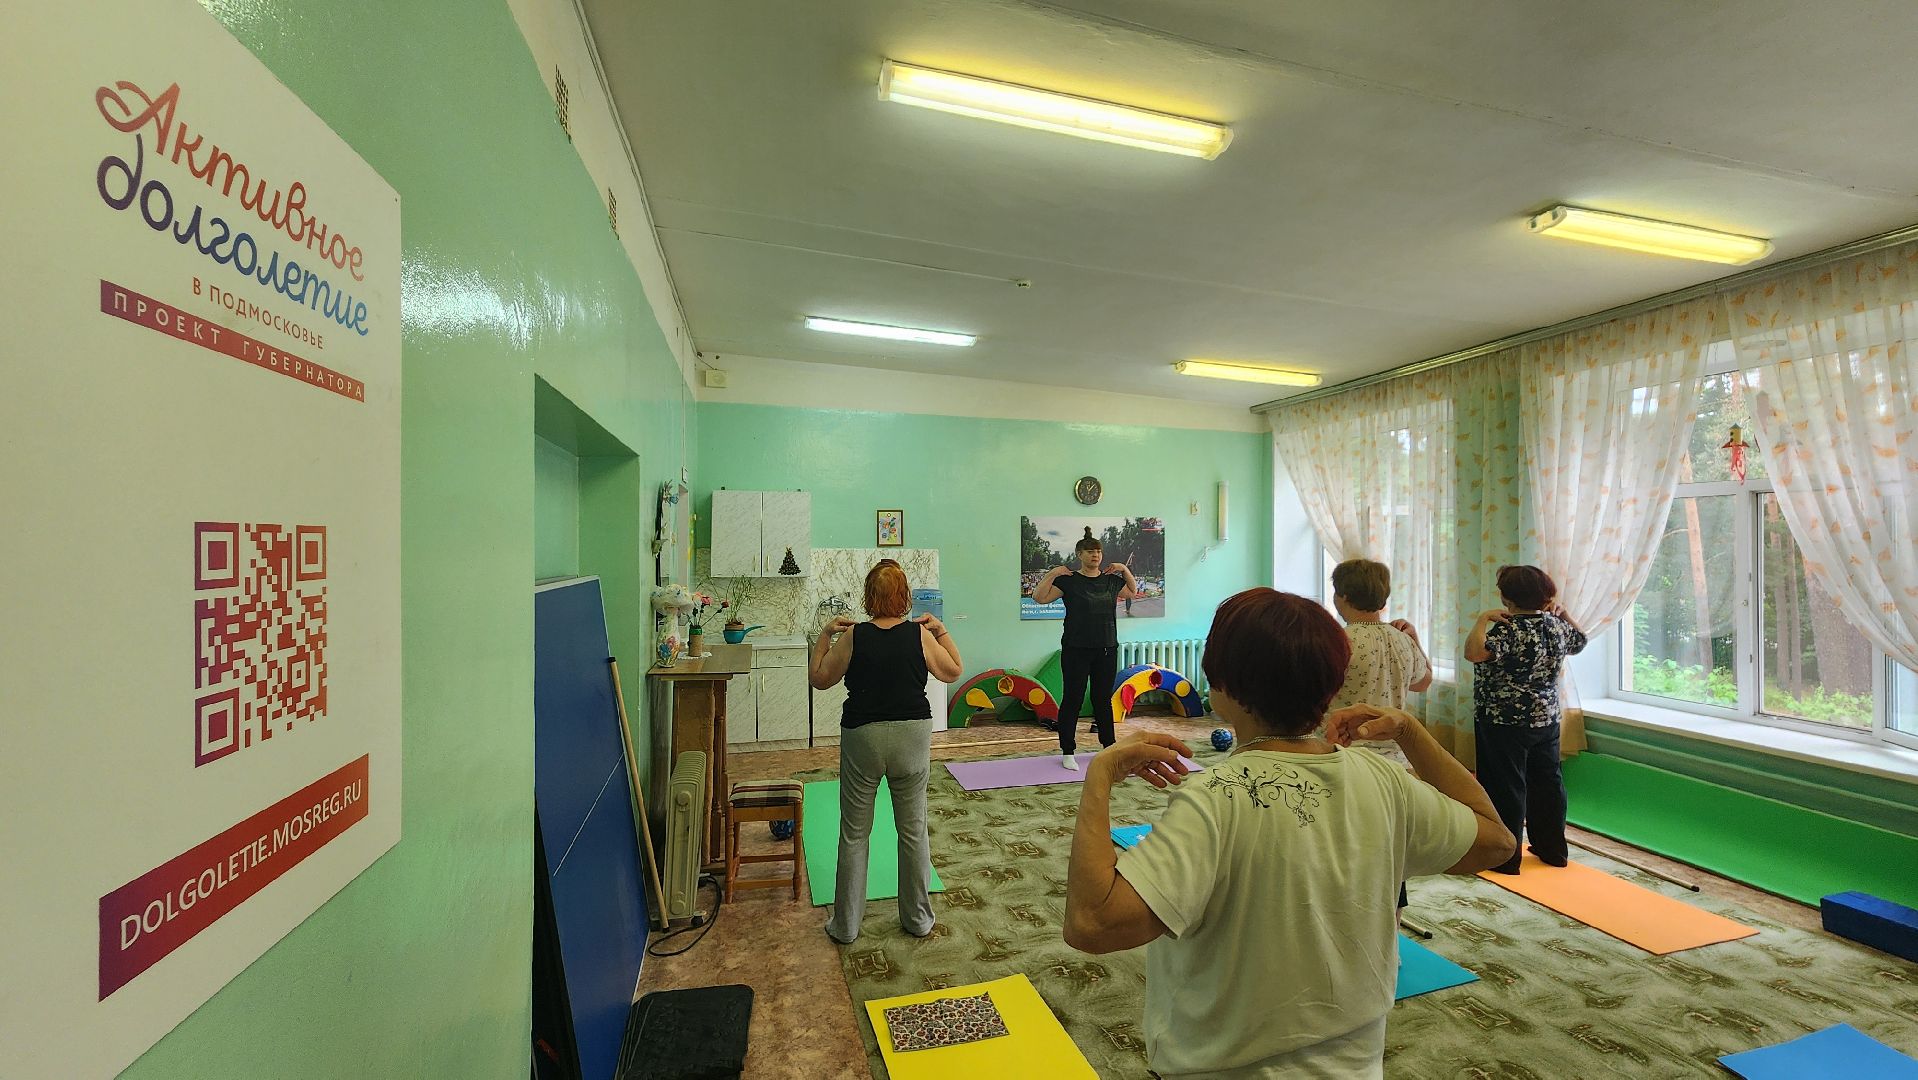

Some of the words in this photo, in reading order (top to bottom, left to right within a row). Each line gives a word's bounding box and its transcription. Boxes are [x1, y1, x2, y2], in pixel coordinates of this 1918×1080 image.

[95, 80, 364, 282] Активное
[96, 133, 369, 336] долголетие
[114, 291, 222, 345] ПРОЕКТ
[243, 340, 363, 398] ГУБЕРНАТОРА
[193, 276, 201, 296] В
[210, 284, 324, 350] ПОДМОСКОВЬЕ
[120, 778, 362, 951] DOLGOLETIE.MOSREG.RU
